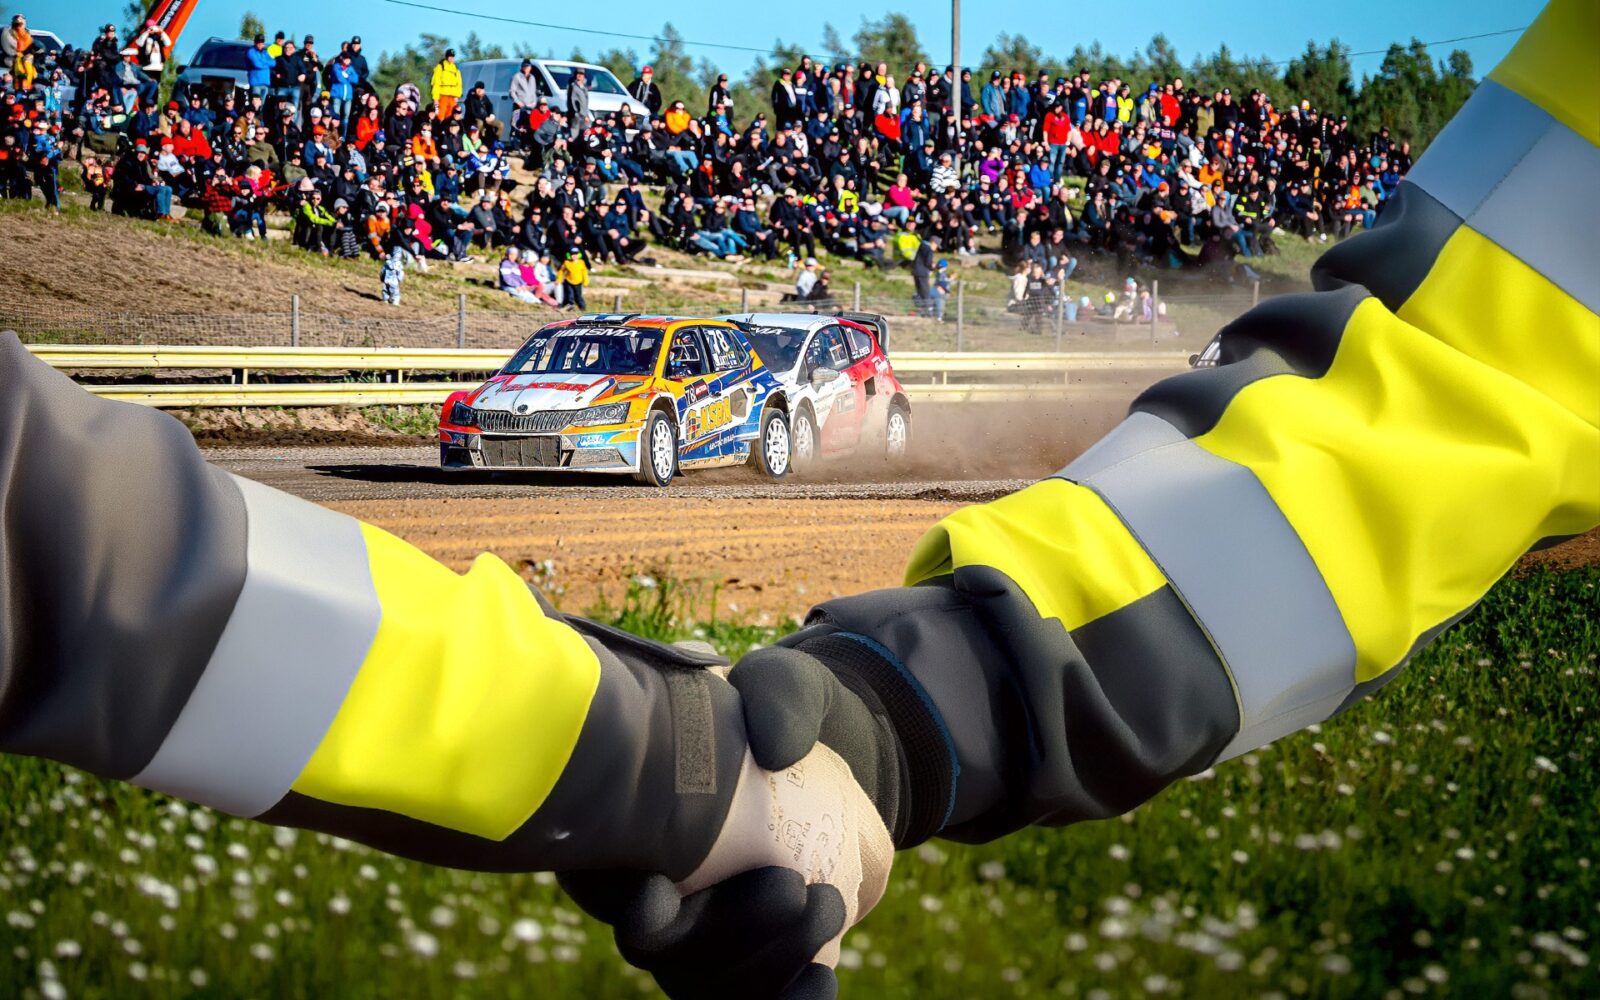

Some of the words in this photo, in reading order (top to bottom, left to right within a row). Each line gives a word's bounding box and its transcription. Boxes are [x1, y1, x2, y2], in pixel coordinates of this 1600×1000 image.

[529, 338, 547, 347] 78
[708, 330, 730, 354] 78
[685, 388, 697, 404] 78
